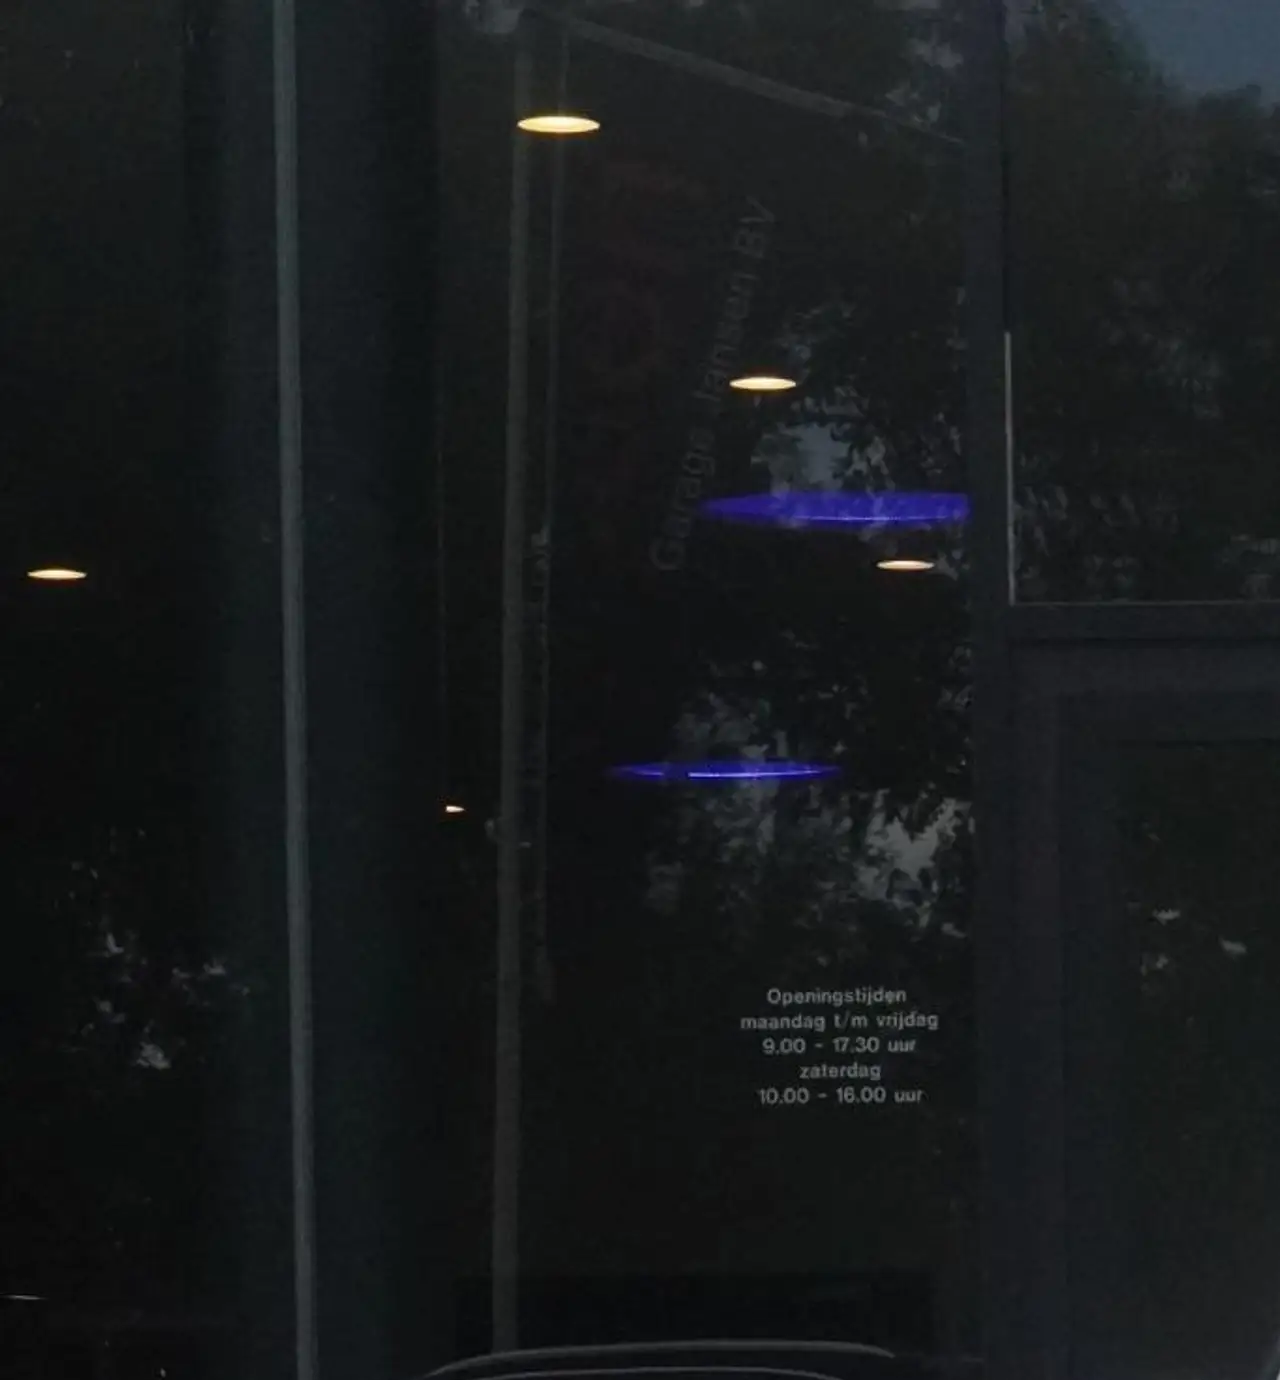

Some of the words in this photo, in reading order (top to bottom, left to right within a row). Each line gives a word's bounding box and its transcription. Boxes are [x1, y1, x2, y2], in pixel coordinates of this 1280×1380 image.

[766, 986, 907, 1007] Openingstijden
[740, 1013, 826, 1032] maandag
[834, 1011, 868, 1029] t/m
[876, 1011, 939, 1031] vrijdag
[762, 1037, 807, 1055] 9.00
[832, 1036, 880, 1053] 17.30
[887, 1040, 916, 1053] uur
[799, 1062, 882, 1081] zaterdag
[757, 1087, 811, 1105] 10.00
[836, 1086, 887, 1104] 16.00
[894, 1089, 924, 1103] uur
